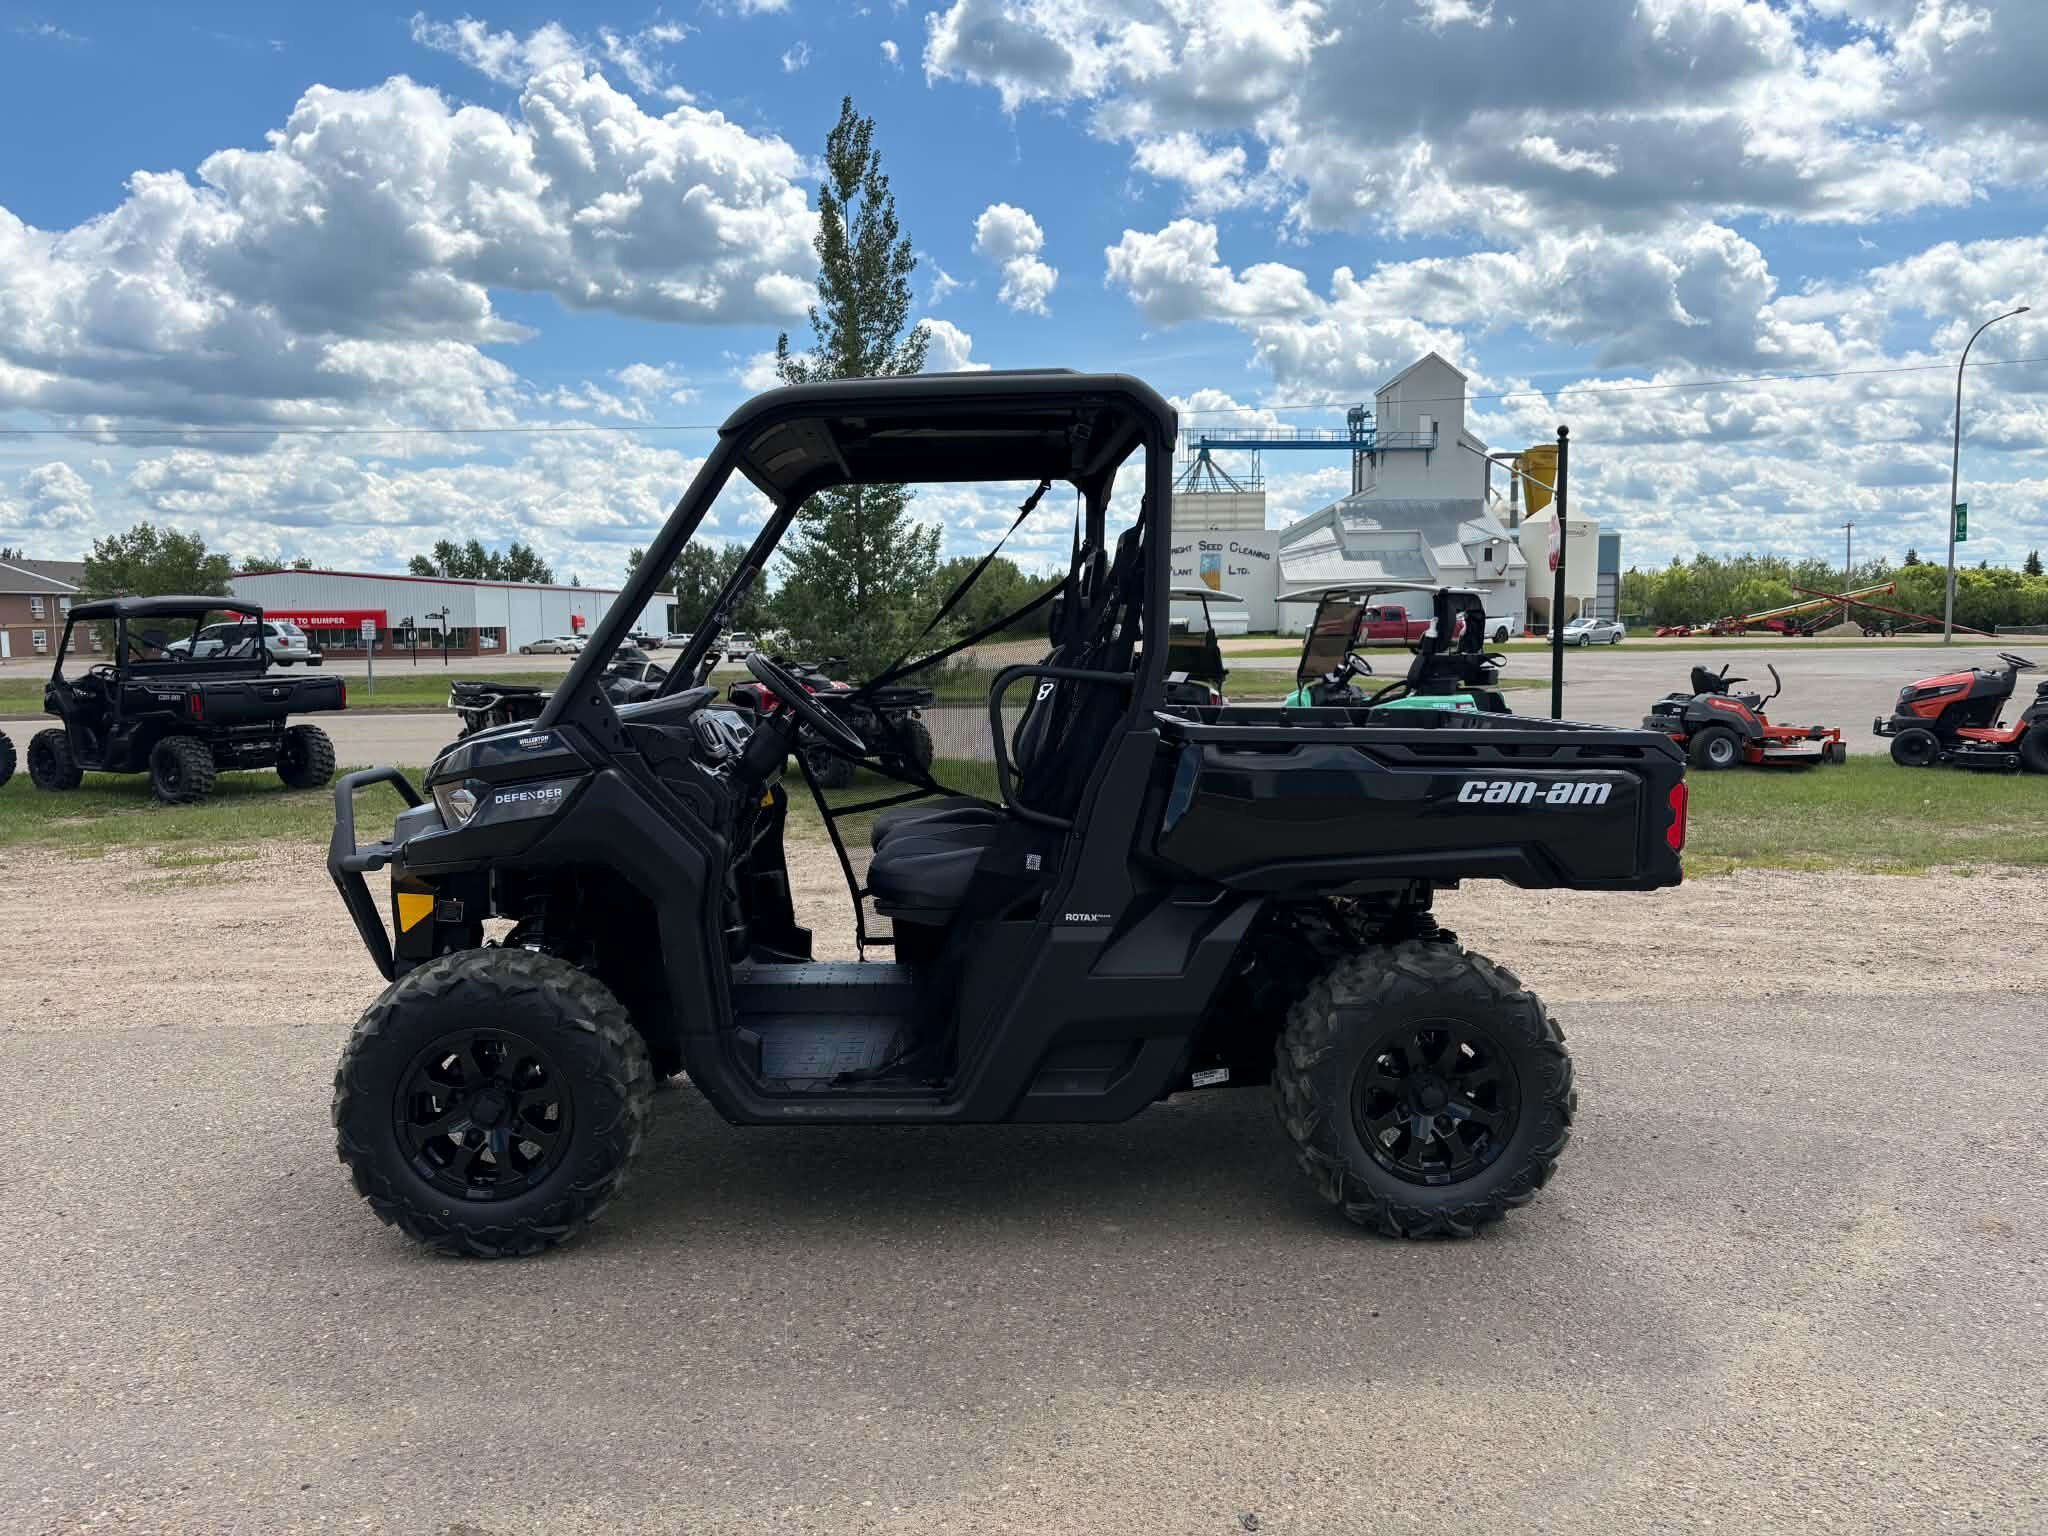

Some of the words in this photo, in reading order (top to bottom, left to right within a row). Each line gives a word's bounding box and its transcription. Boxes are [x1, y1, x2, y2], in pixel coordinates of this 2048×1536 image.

[1199, 540, 1223, 551] SEED
[1229, 542, 1270, 560] CLEANING
[1170, 566, 1192, 576] LANT
[297, 617, 309, 625] TO
[495, 788, 562, 804] DEFENDER
[1457, 781, 1612, 804] can-am
[1065, 913, 1097, 921] ROTAX
